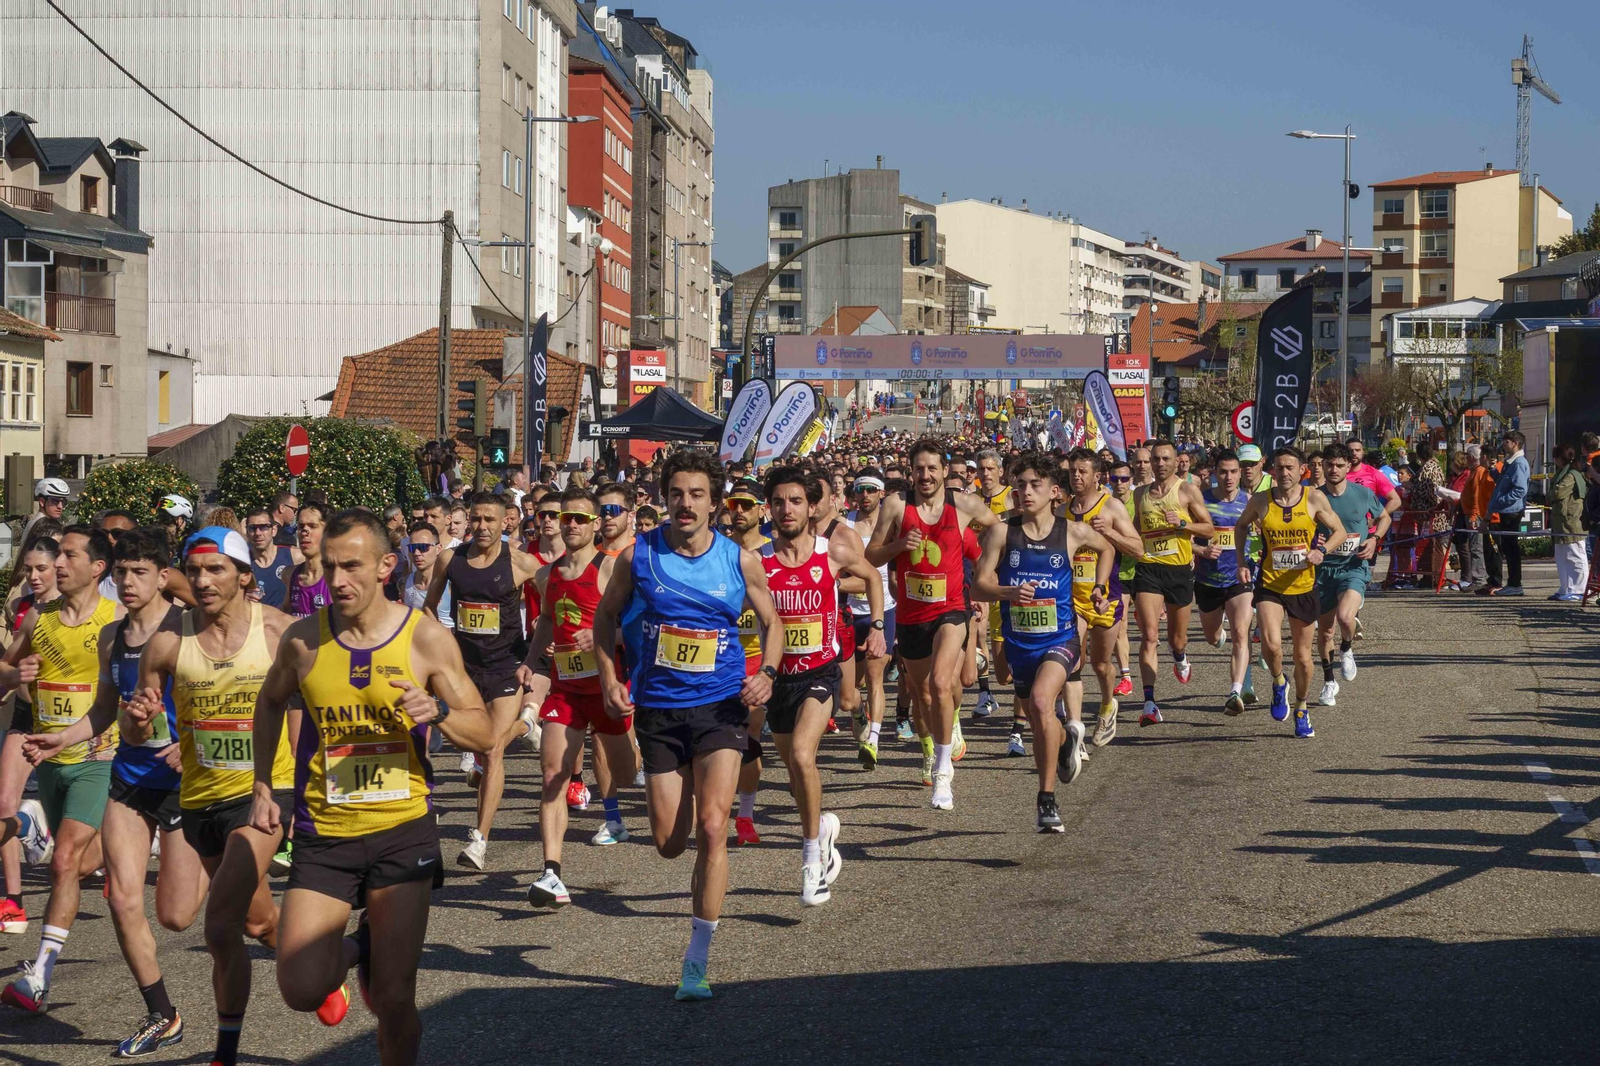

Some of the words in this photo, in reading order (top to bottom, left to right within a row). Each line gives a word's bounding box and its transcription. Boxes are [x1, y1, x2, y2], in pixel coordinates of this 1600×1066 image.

[839, 347, 872, 358] Porriño
[934, 347, 967, 358] Porriño
[1029, 347, 1062, 358] Porriño
[901, 370, 942, 378] 00:00:12
[1114, 388, 1144, 397] GADIS
[733, 388, 764, 435] Porriño
[772, 391, 806, 433] Porriño
[1240, 415, 1252, 429] 3
[1267, 529, 1308, 538] TANINOS
[1153, 540, 1168, 552] 132
[1281, 554, 1299, 565] 440
[918, 584, 932, 597] 43
[470, 614, 485, 627] 97
[1019, 611, 1048, 626] 2196
[785, 630, 809, 646] 128
[677, 643, 700, 664] 87
[568, 656, 584, 672] 46
[54, 697, 73, 716] 54
[219, 703, 252, 714] Lázaro
[315, 704, 404, 725] TANINOS
[211, 738, 251, 760] 2181
[354, 764, 384, 790] 114
